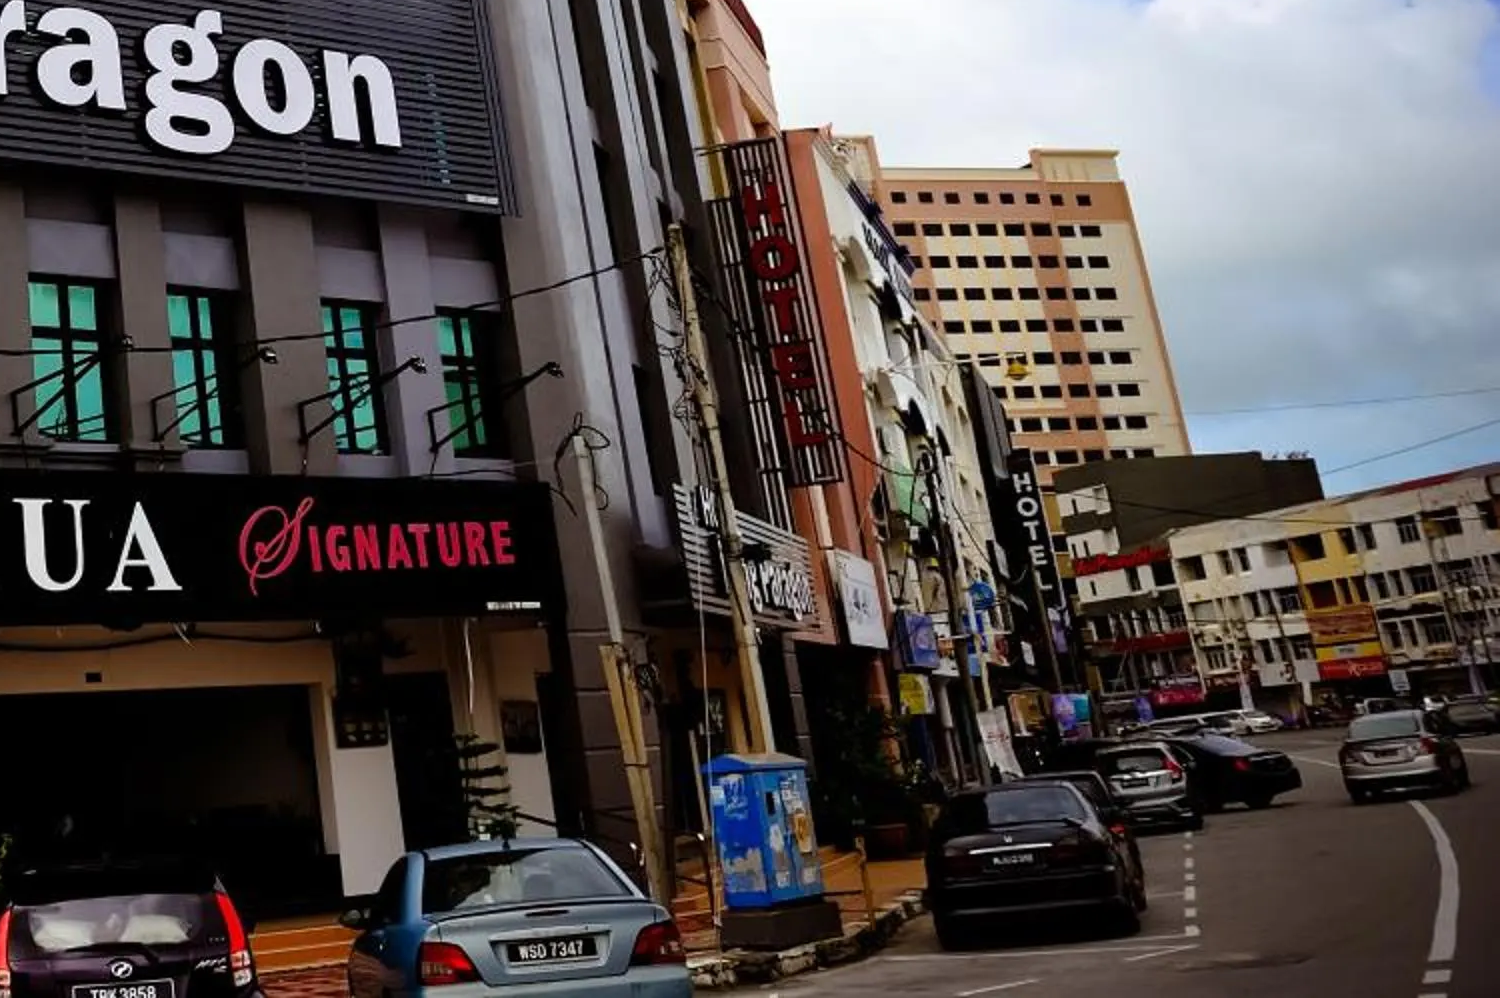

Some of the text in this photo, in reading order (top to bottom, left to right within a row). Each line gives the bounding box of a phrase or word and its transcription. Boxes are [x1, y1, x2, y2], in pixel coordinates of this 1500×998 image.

[742, 183, 827, 445] HOTEL
[238, 497, 516, 597] SIGNATURE
[1011, 471, 1054, 592] HOTEL
[550, 939, 584, 958] 7347
